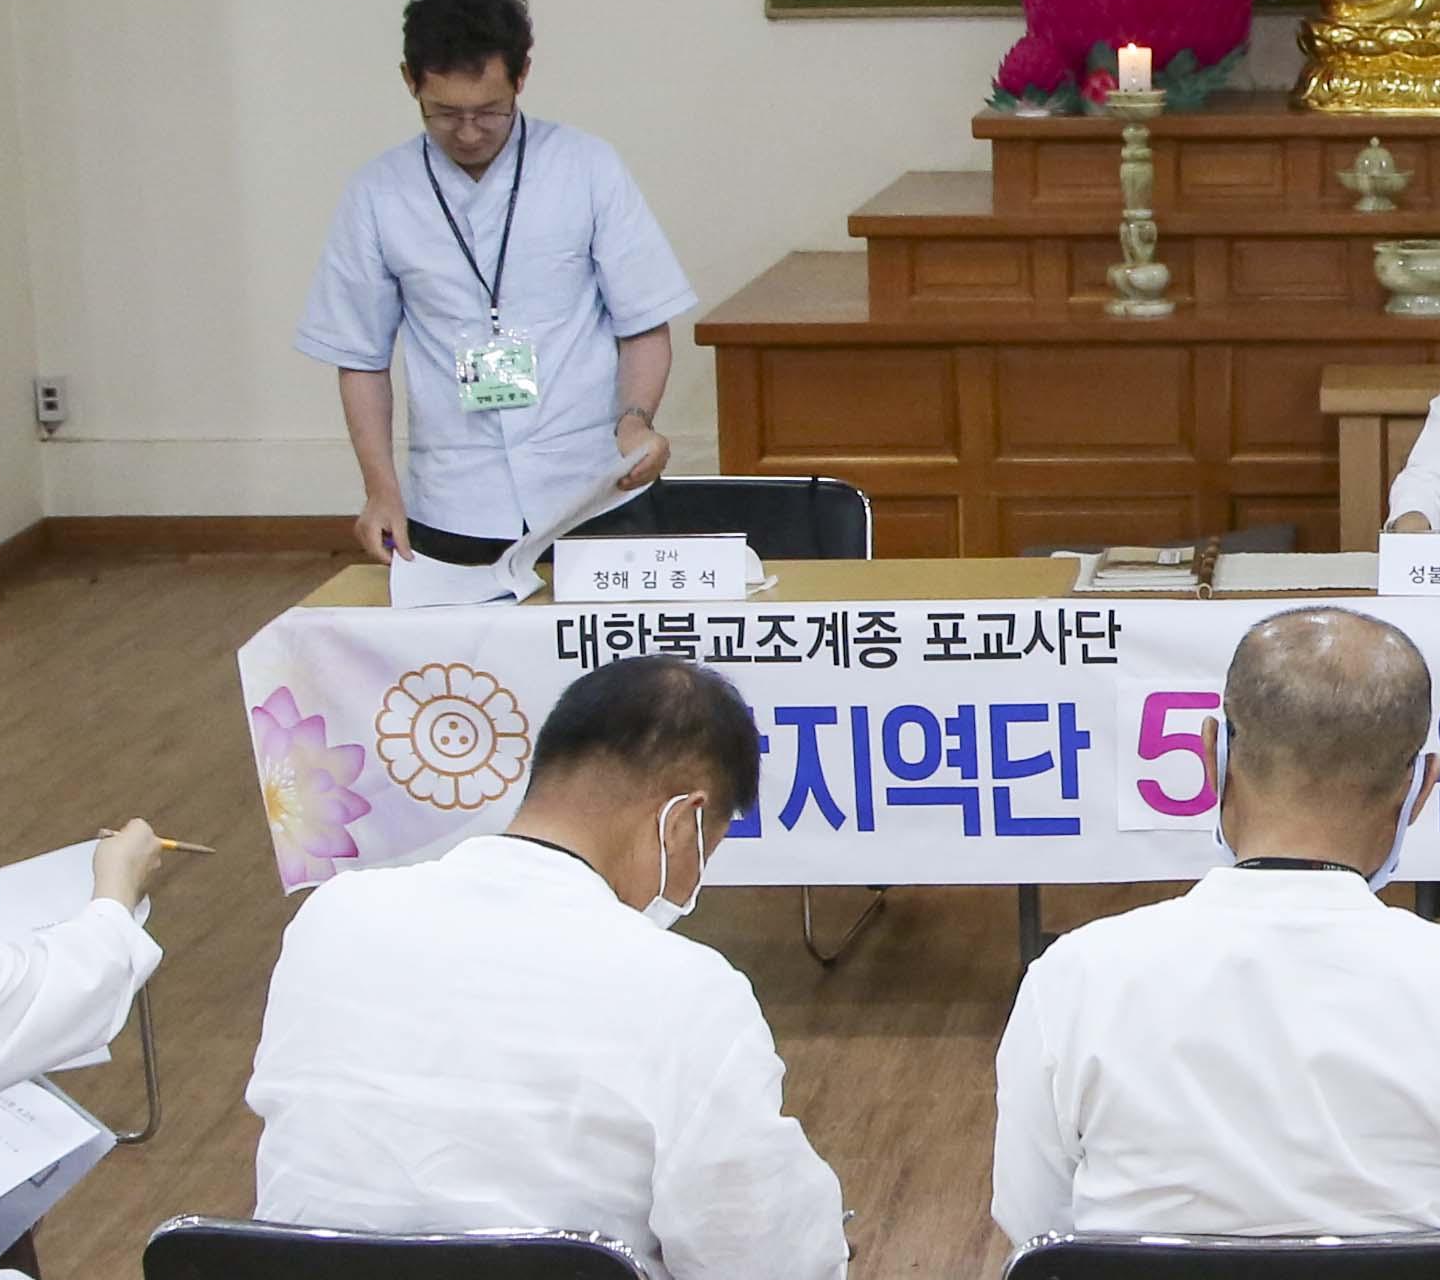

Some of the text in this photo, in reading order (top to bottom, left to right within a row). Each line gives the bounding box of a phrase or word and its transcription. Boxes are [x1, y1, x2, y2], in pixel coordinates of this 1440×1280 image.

[655, 549, 680, 563] 감사
[593, 570, 630, 590] 청해
[922, 606, 1123, 666] 포교사단
[726, 702, 1091, 839] 지역단
